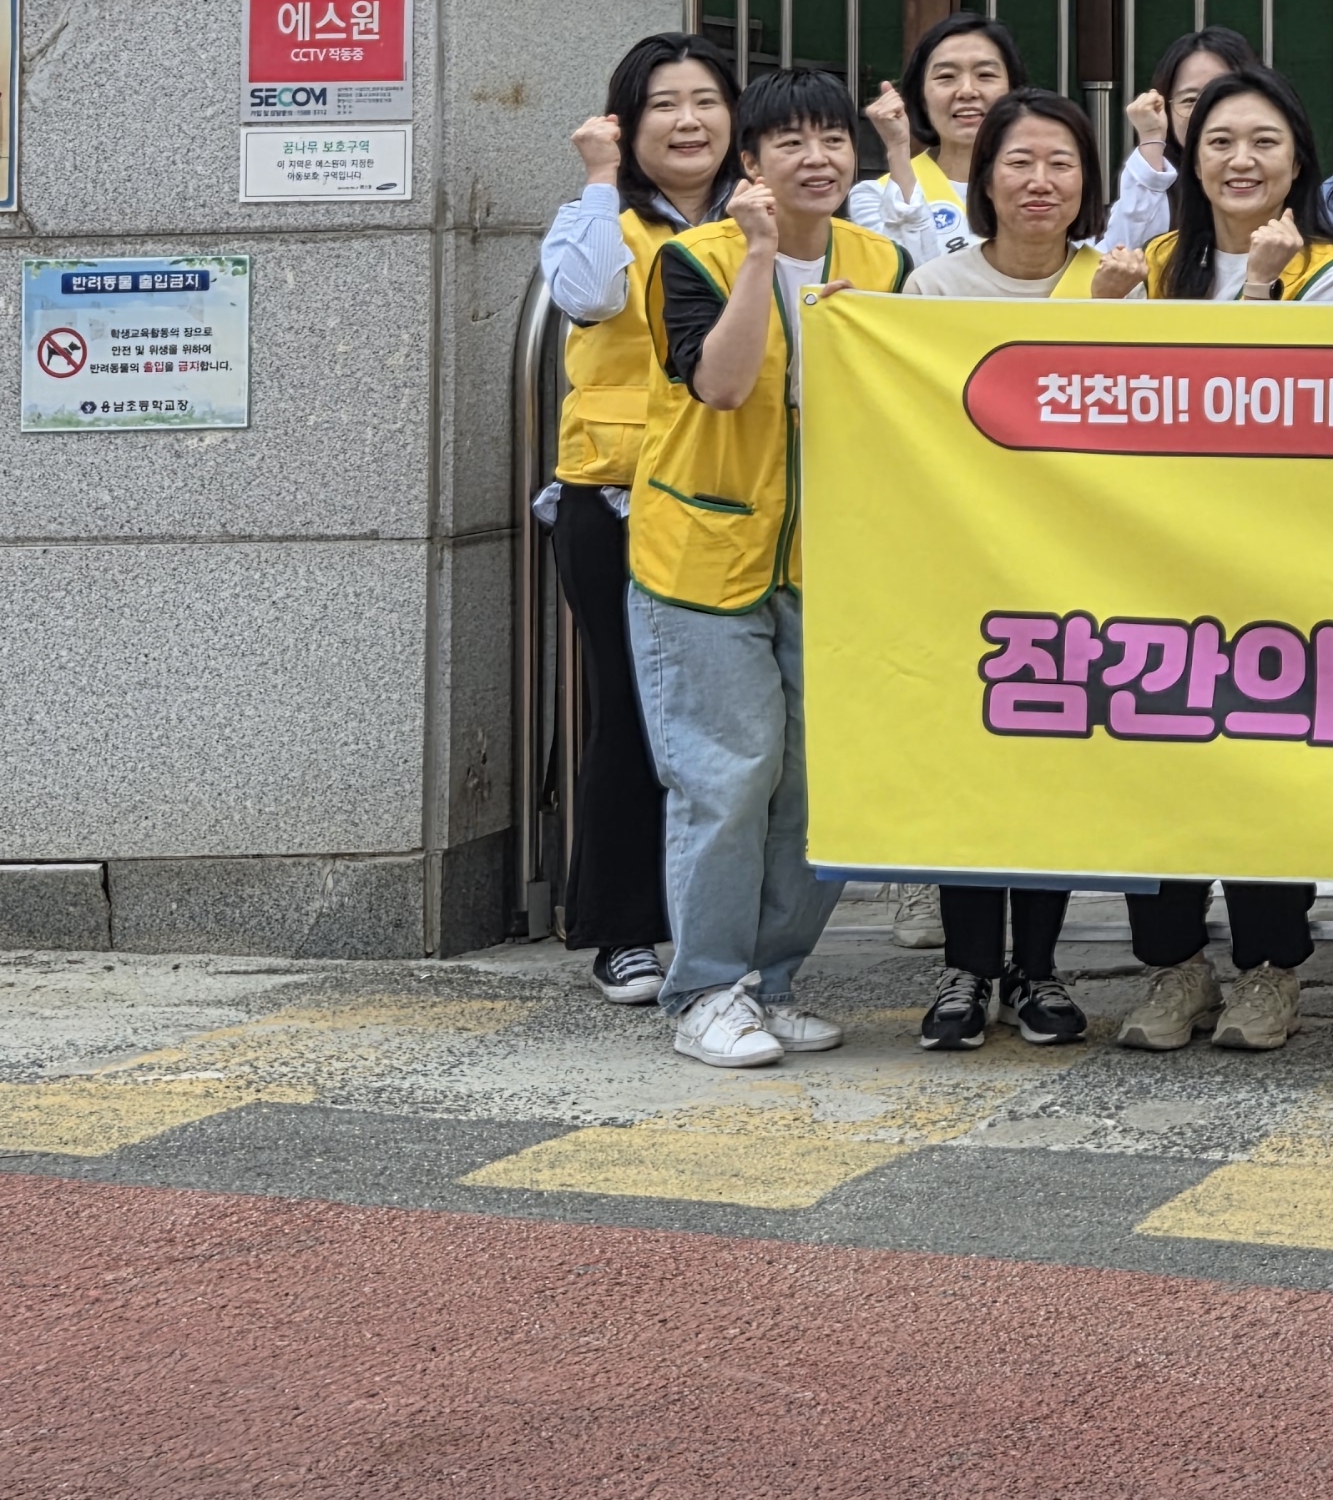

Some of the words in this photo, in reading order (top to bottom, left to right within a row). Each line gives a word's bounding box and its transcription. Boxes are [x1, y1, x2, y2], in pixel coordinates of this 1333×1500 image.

[277, 0, 380, 41] 에스원
[291, 49, 326, 62] CCTV
[329, 47, 364, 62] 작동중
[250, 87, 327, 107] SECOM
[283, 141, 318, 154] 꿈나무
[322, 140, 370, 153] 보호구역
[277, 160, 285, 169] 이
[288, 160, 312, 169] 지역은
[350, 159, 374, 168] 지정한
[72, 275, 132, 290] 반려동물
[139, 274, 199, 289] 출입금지
[183, 326, 213, 338] 장으로
[111, 345, 131, 356] 안전
[135, 345, 144, 356] 및
[149, 344, 178, 355] 위생을
[182, 344, 211, 354] 위하여
[89, 363, 139, 374] 반려동물의
[143, 362, 173, 373] 출입을
[178, 361, 233, 372] 금지합니다.
[1035, 372, 1190, 425] 천천히!
[100, 400, 189, 414] 용남초등학교장
